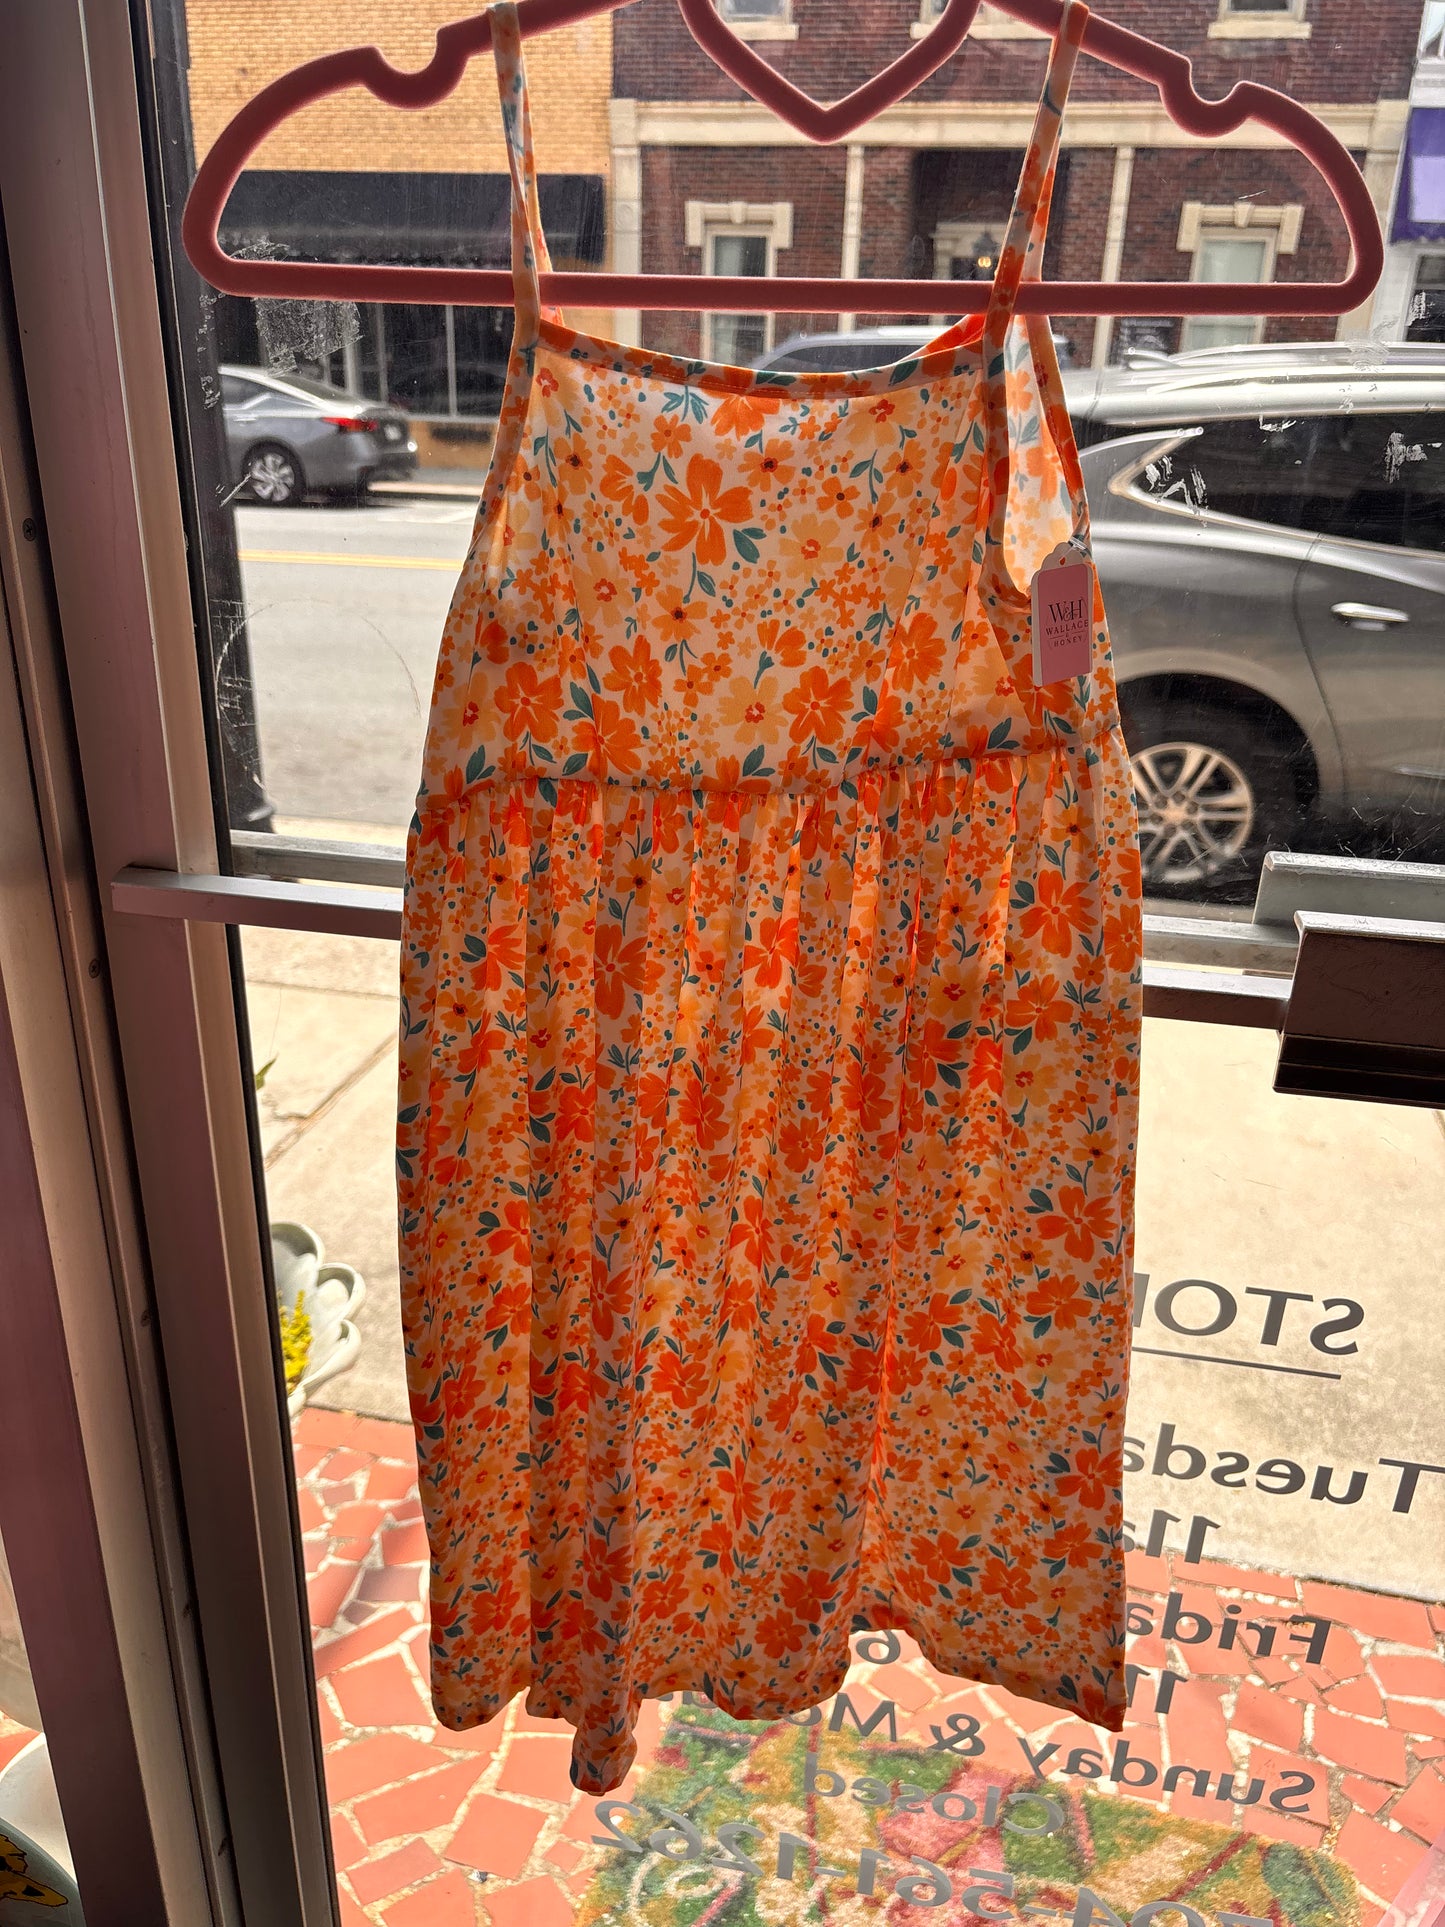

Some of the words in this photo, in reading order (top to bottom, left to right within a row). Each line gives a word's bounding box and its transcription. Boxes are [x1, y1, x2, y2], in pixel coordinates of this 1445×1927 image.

[1047, 598, 1084, 623] W&H
[1045, 619, 1089, 636] WALLACE
[1053, 635, 1083, 648] HONEY
